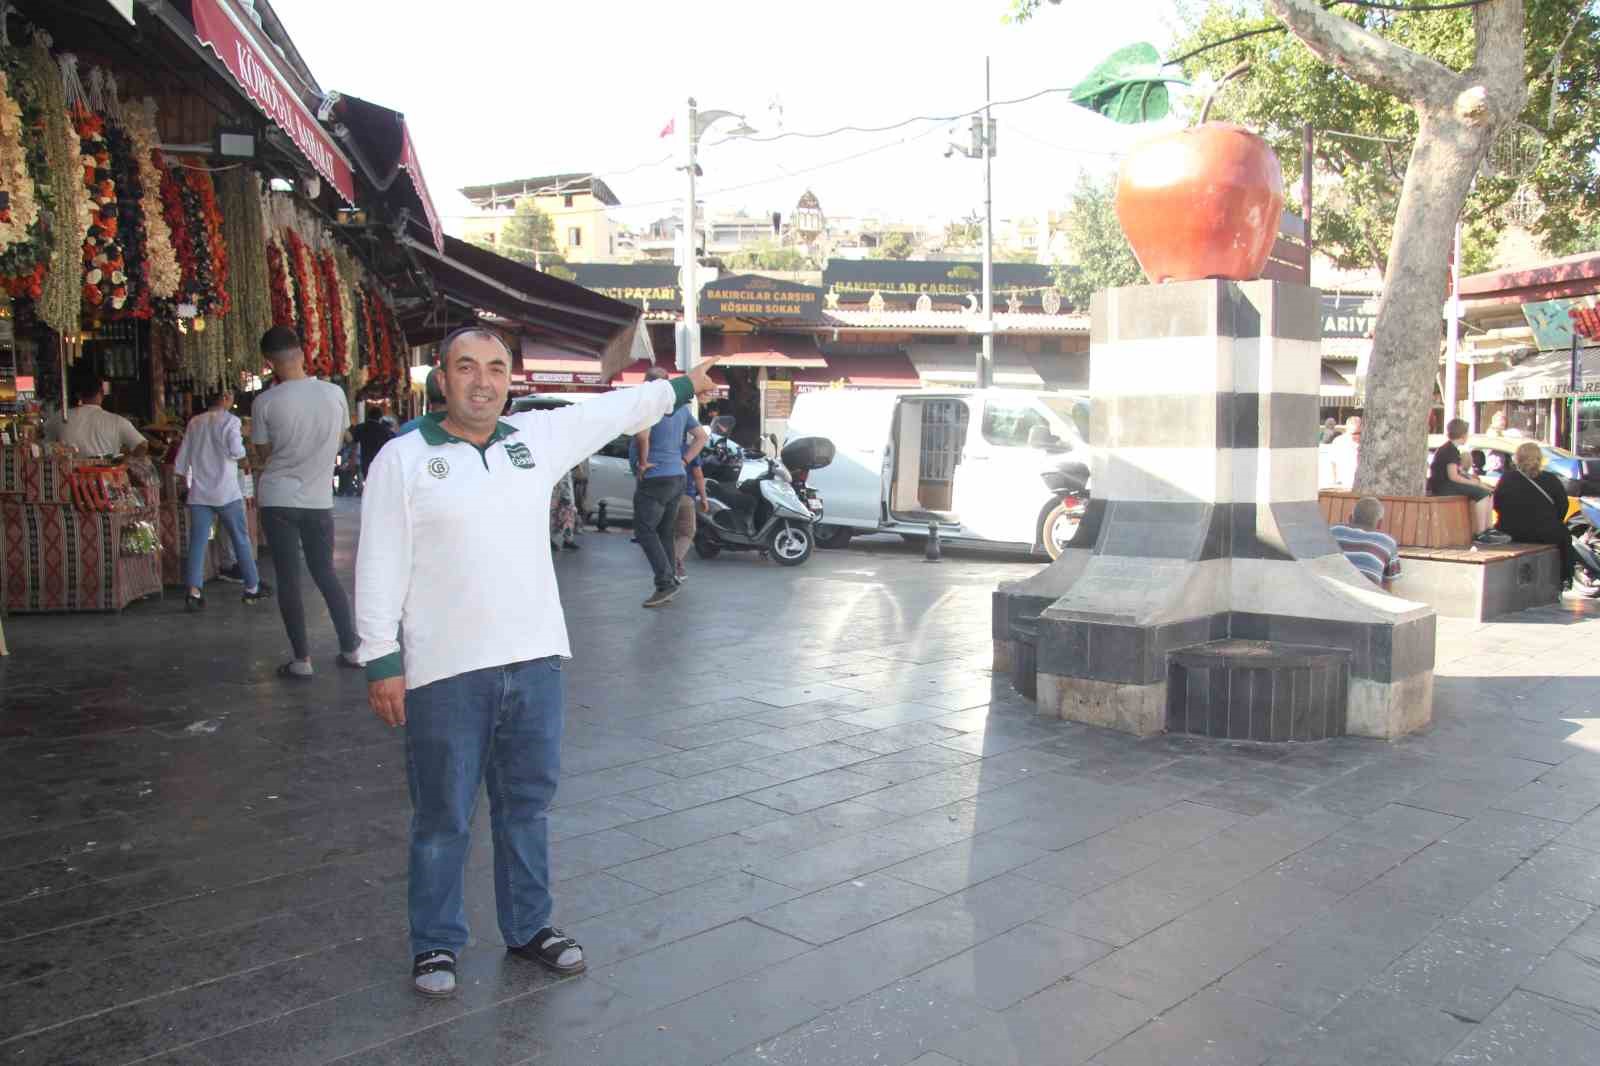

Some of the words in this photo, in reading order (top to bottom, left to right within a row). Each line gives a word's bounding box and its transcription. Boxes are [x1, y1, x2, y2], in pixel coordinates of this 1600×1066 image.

[624, 287, 675, 301] PAZARI
[707, 289, 771, 302] BAKIRCILAR
[765, 304, 801, 314] SOKAK
